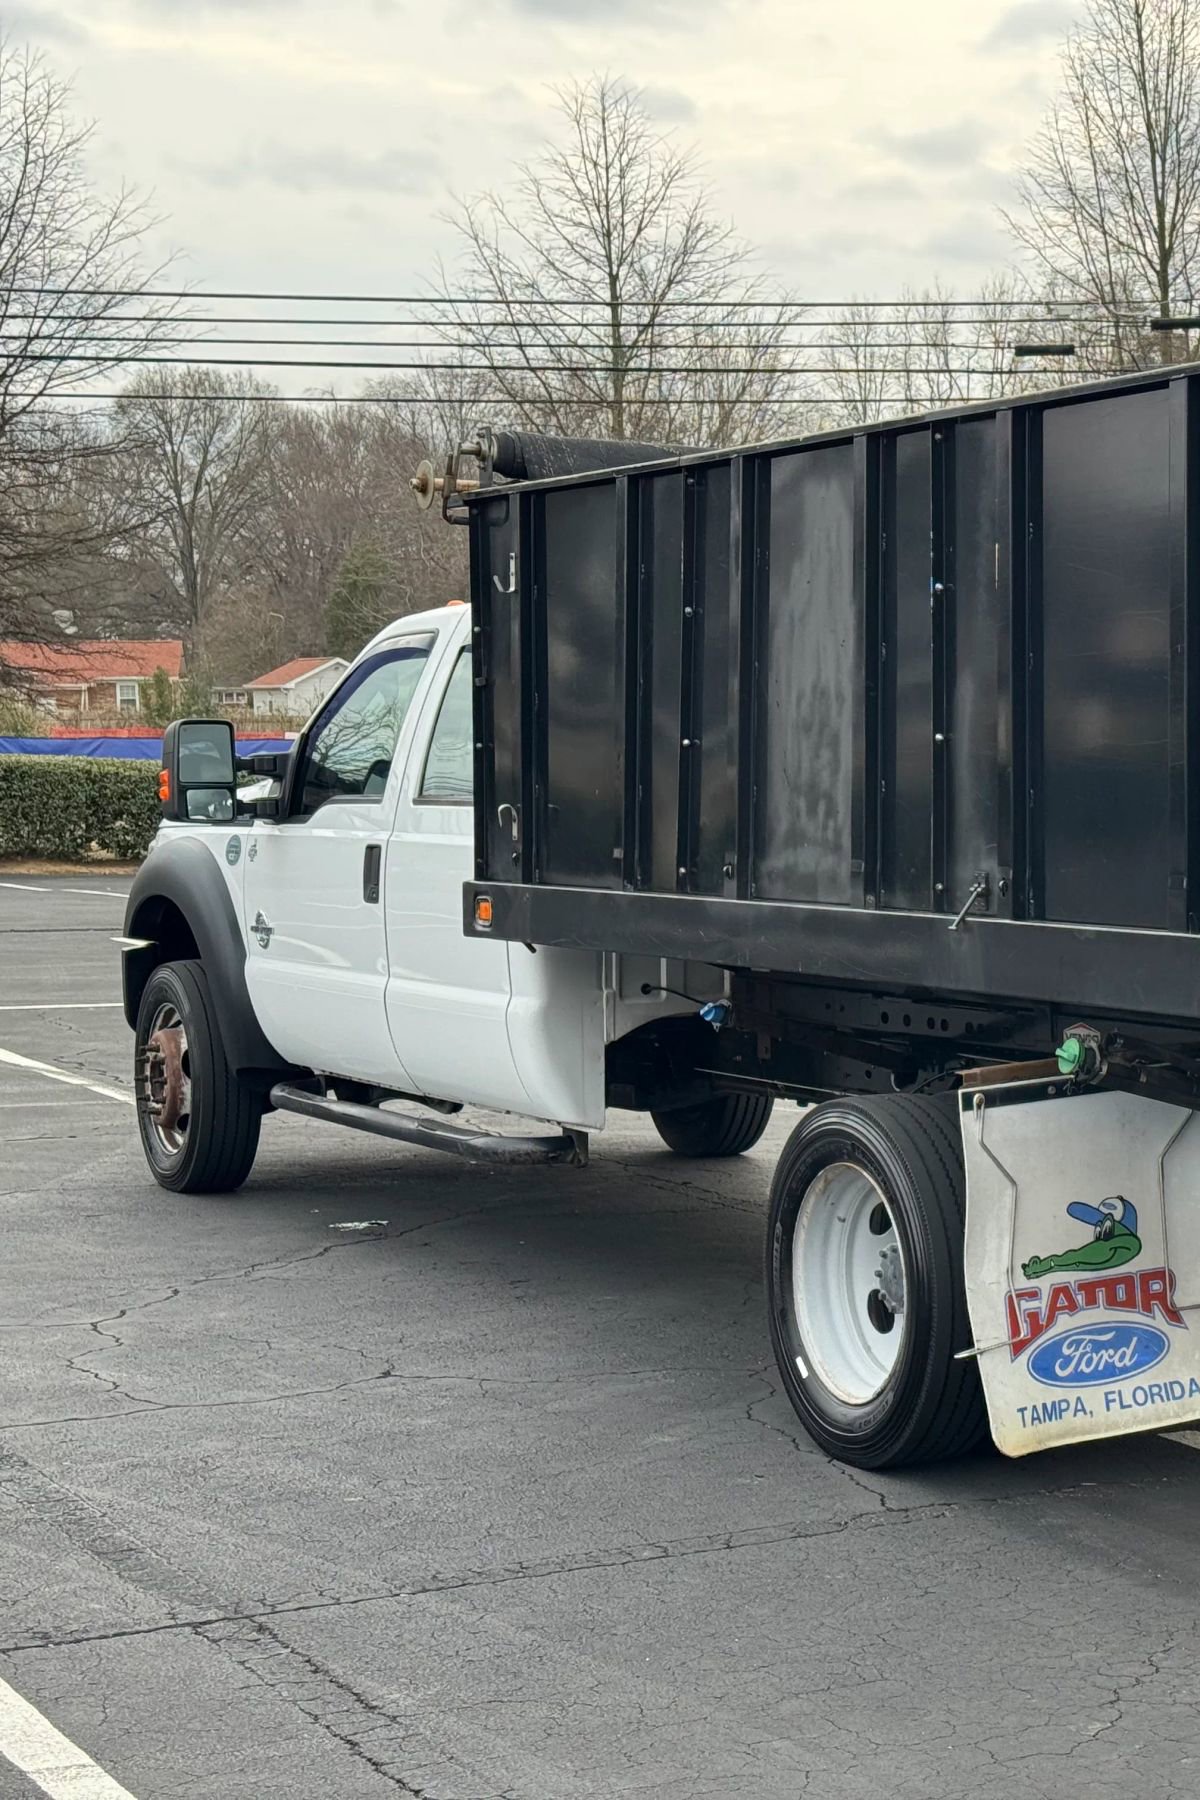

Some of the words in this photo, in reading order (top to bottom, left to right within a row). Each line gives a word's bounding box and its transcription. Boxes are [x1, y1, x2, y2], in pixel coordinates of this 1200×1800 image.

[1004, 1266, 1189, 1364] GATOR
[1054, 1330, 1139, 1378] Ford
[1017, 1396, 1093, 1428] TAMPA,
